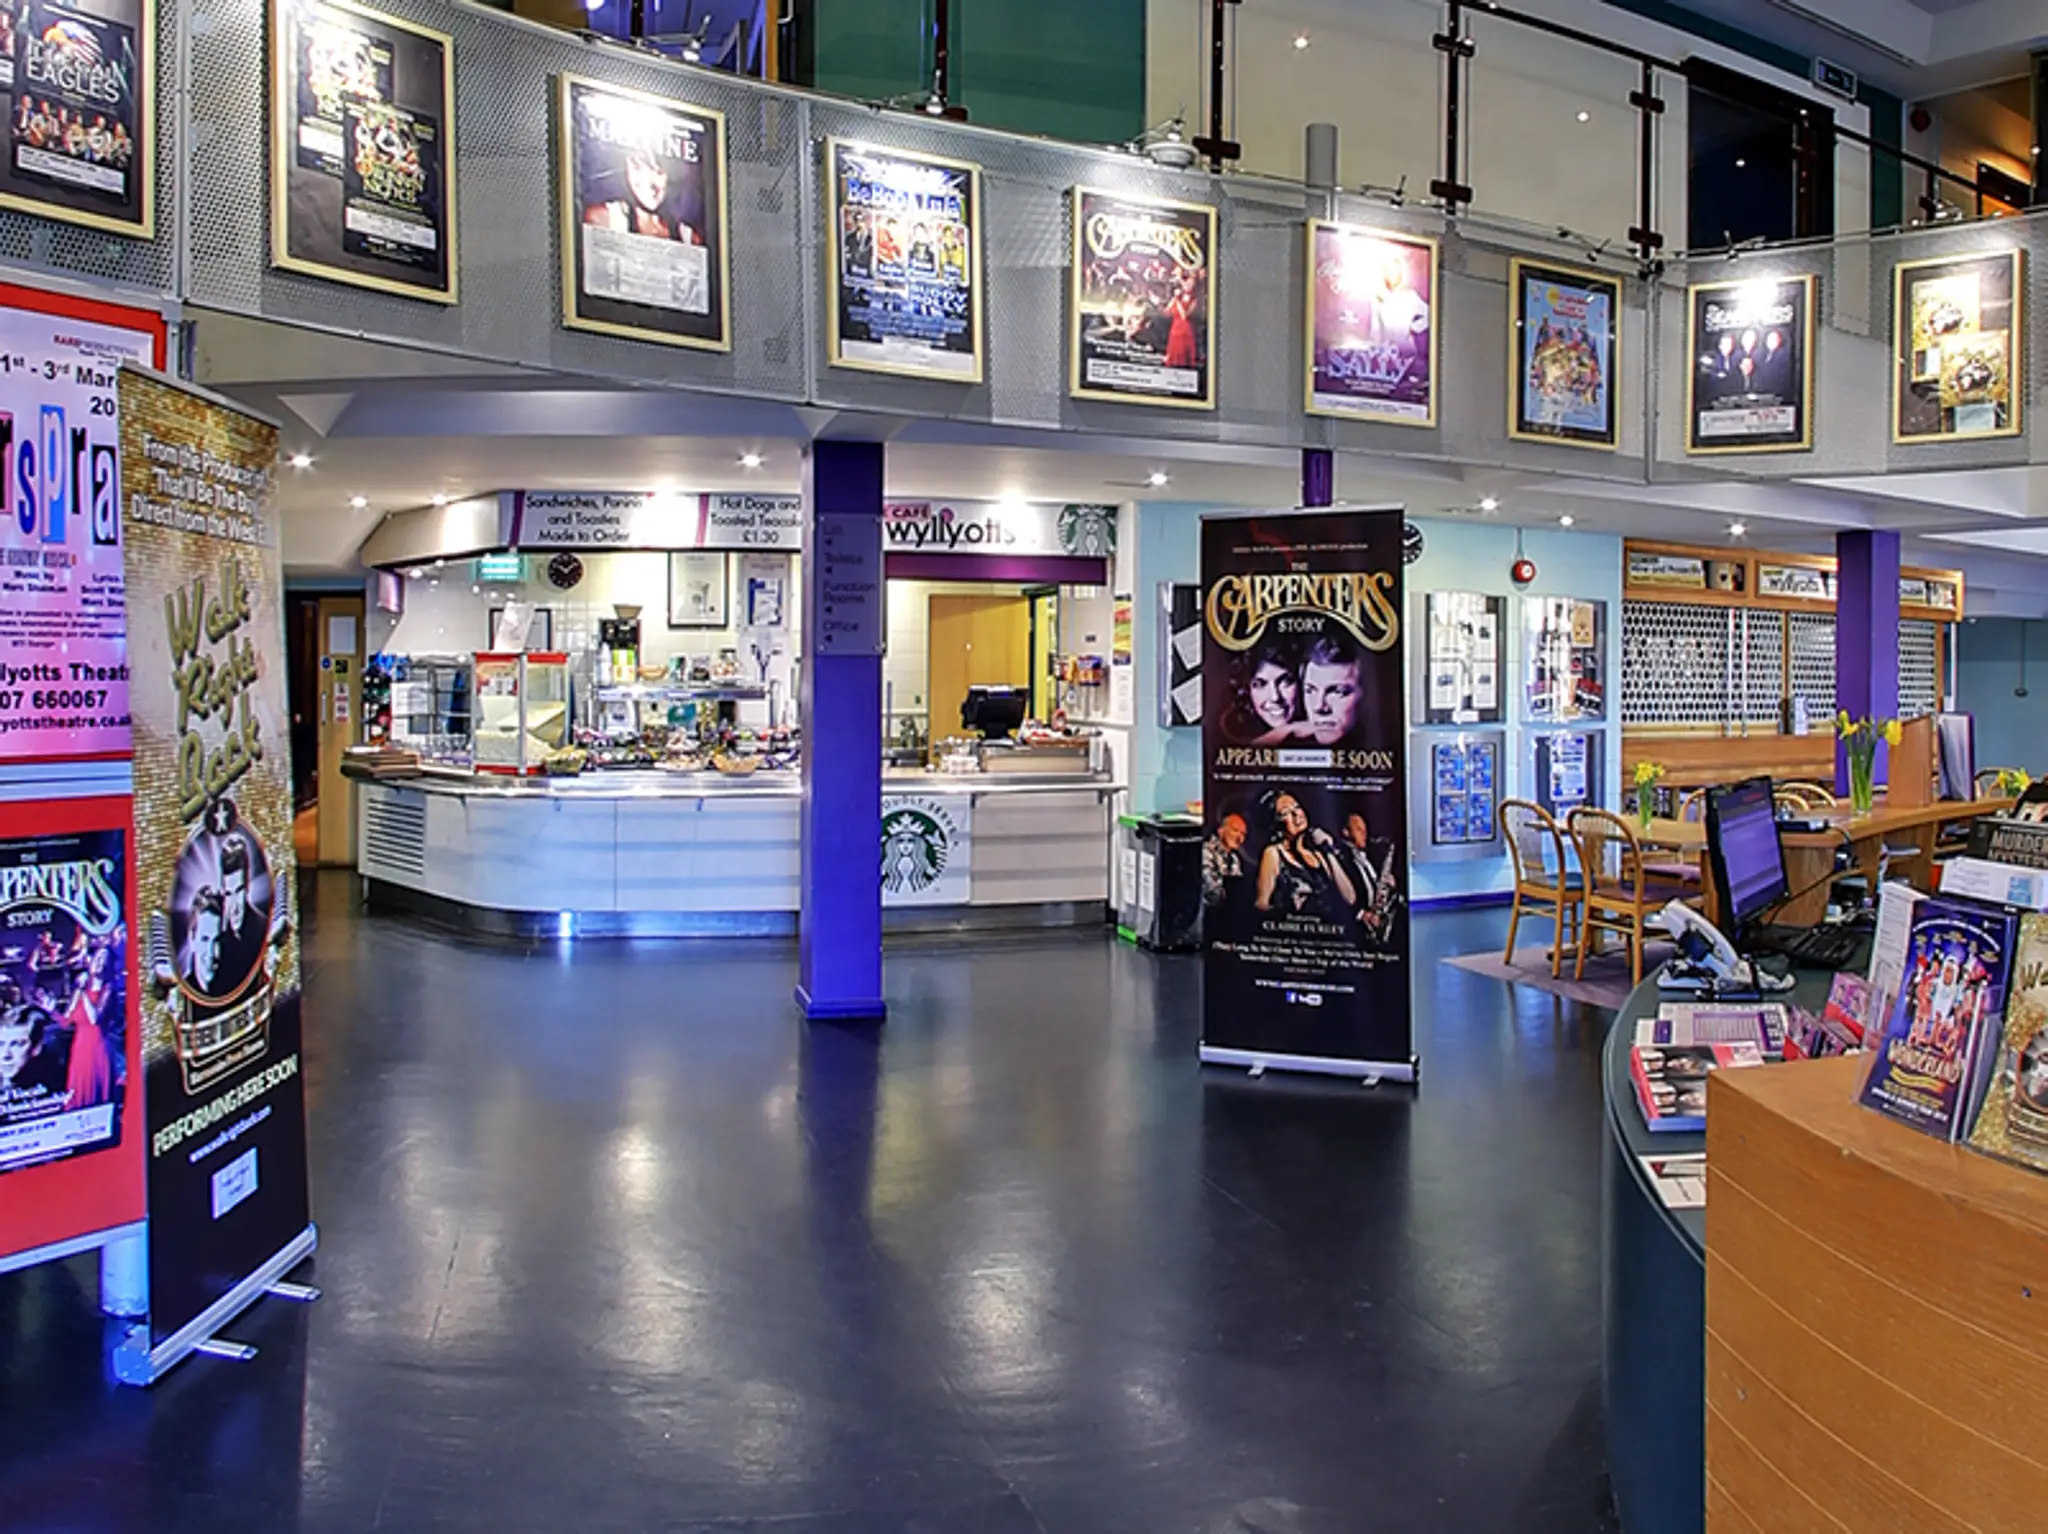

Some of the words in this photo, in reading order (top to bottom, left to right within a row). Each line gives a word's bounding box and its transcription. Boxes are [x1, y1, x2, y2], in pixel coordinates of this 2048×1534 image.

[27, 56, 121, 103] EAGLES
[44, 360, 70, 381] 3rd
[76, 365, 114, 388] Mar
[90, 395, 116, 416] 20
[526, 495, 600, 510] Sandwiches,
[719, 497, 742, 509] Hot
[744, 497, 776, 514] Dogs
[547, 512, 572, 525] and
[711, 512, 756, 527] Toasted
[538, 530, 575, 543] Made
[577, 531, 591, 543] to
[592, 529, 631, 543] Order
[823, 580, 876, 592] Function
[823, 592, 866, 604] Rooms
[163, 550, 249, 670] Walk
[1206, 571, 1400, 652] CARPENTERS
[823, 620, 859, 632] Office
[1276, 616, 1326, 633] STORY
[171, 632, 257, 736] Right
[0, 689, 24, 710] 07
[32, 689, 108, 710] 660067
[1349, 751, 1394, 770] SOON
[6, 907, 55, 929] STORY
[153, 1089, 237, 1158] PERFORMING
[236, 1073, 267, 1108] HERE
[265, 1053, 299, 1089] SOON
